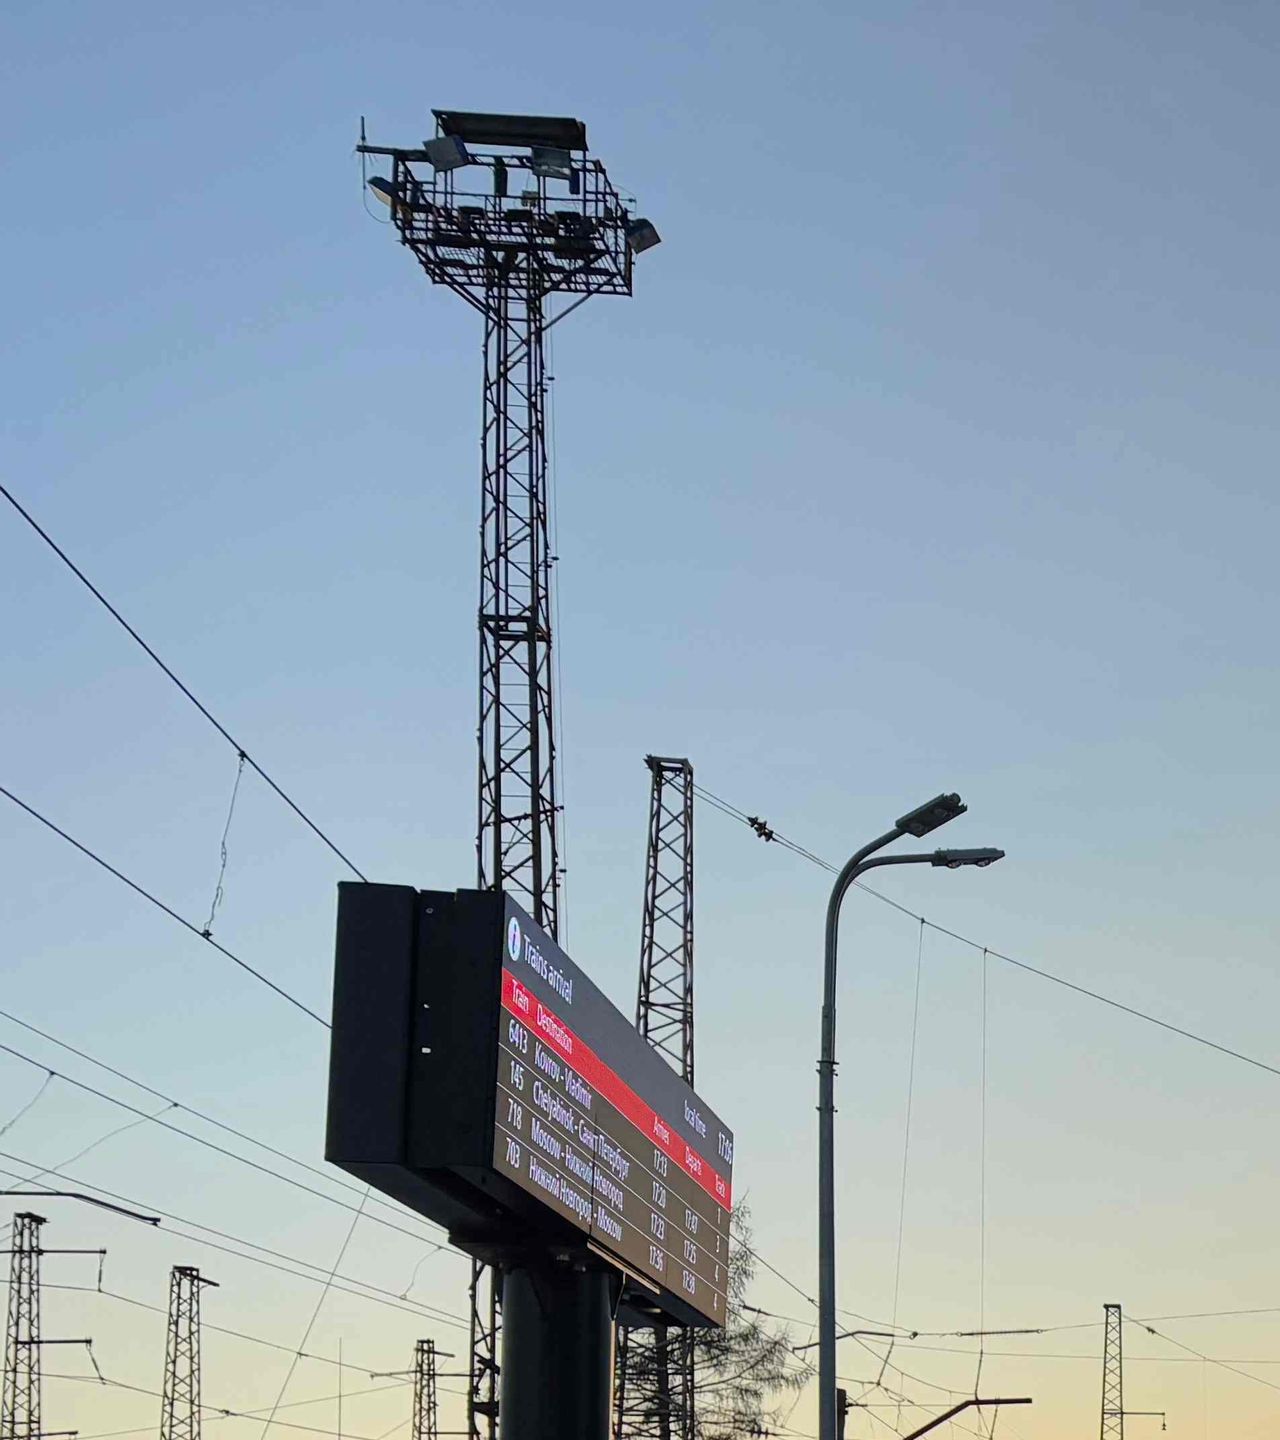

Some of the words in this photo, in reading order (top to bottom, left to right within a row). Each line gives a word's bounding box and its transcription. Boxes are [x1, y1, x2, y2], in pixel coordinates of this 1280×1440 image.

[523, 934, 548, 982] Trains
[548, 967, 573, 1006] arrival
[511, 978, 529, 1015] Train
[536, 1003, 573, 1054] Destination
[508, 1019, 529, 1054] 6413
[565, 1068, 593, 1110] Vladimir
[510, 1060, 525, 1091] 145
[533, 1080, 575, 1134] Chelyabinsk
[507, 1098, 523, 1130] 718
[531, 1117, 562, 1159] Moscow
[684, 1099, 696, 1128] local
[505, 1137, 521, 1169] 703
[529, 1156, 560, 1198] Нижний
[560, 1178, 593, 1225] Новгород
[597, 1206, 623, 1242] Moscow
